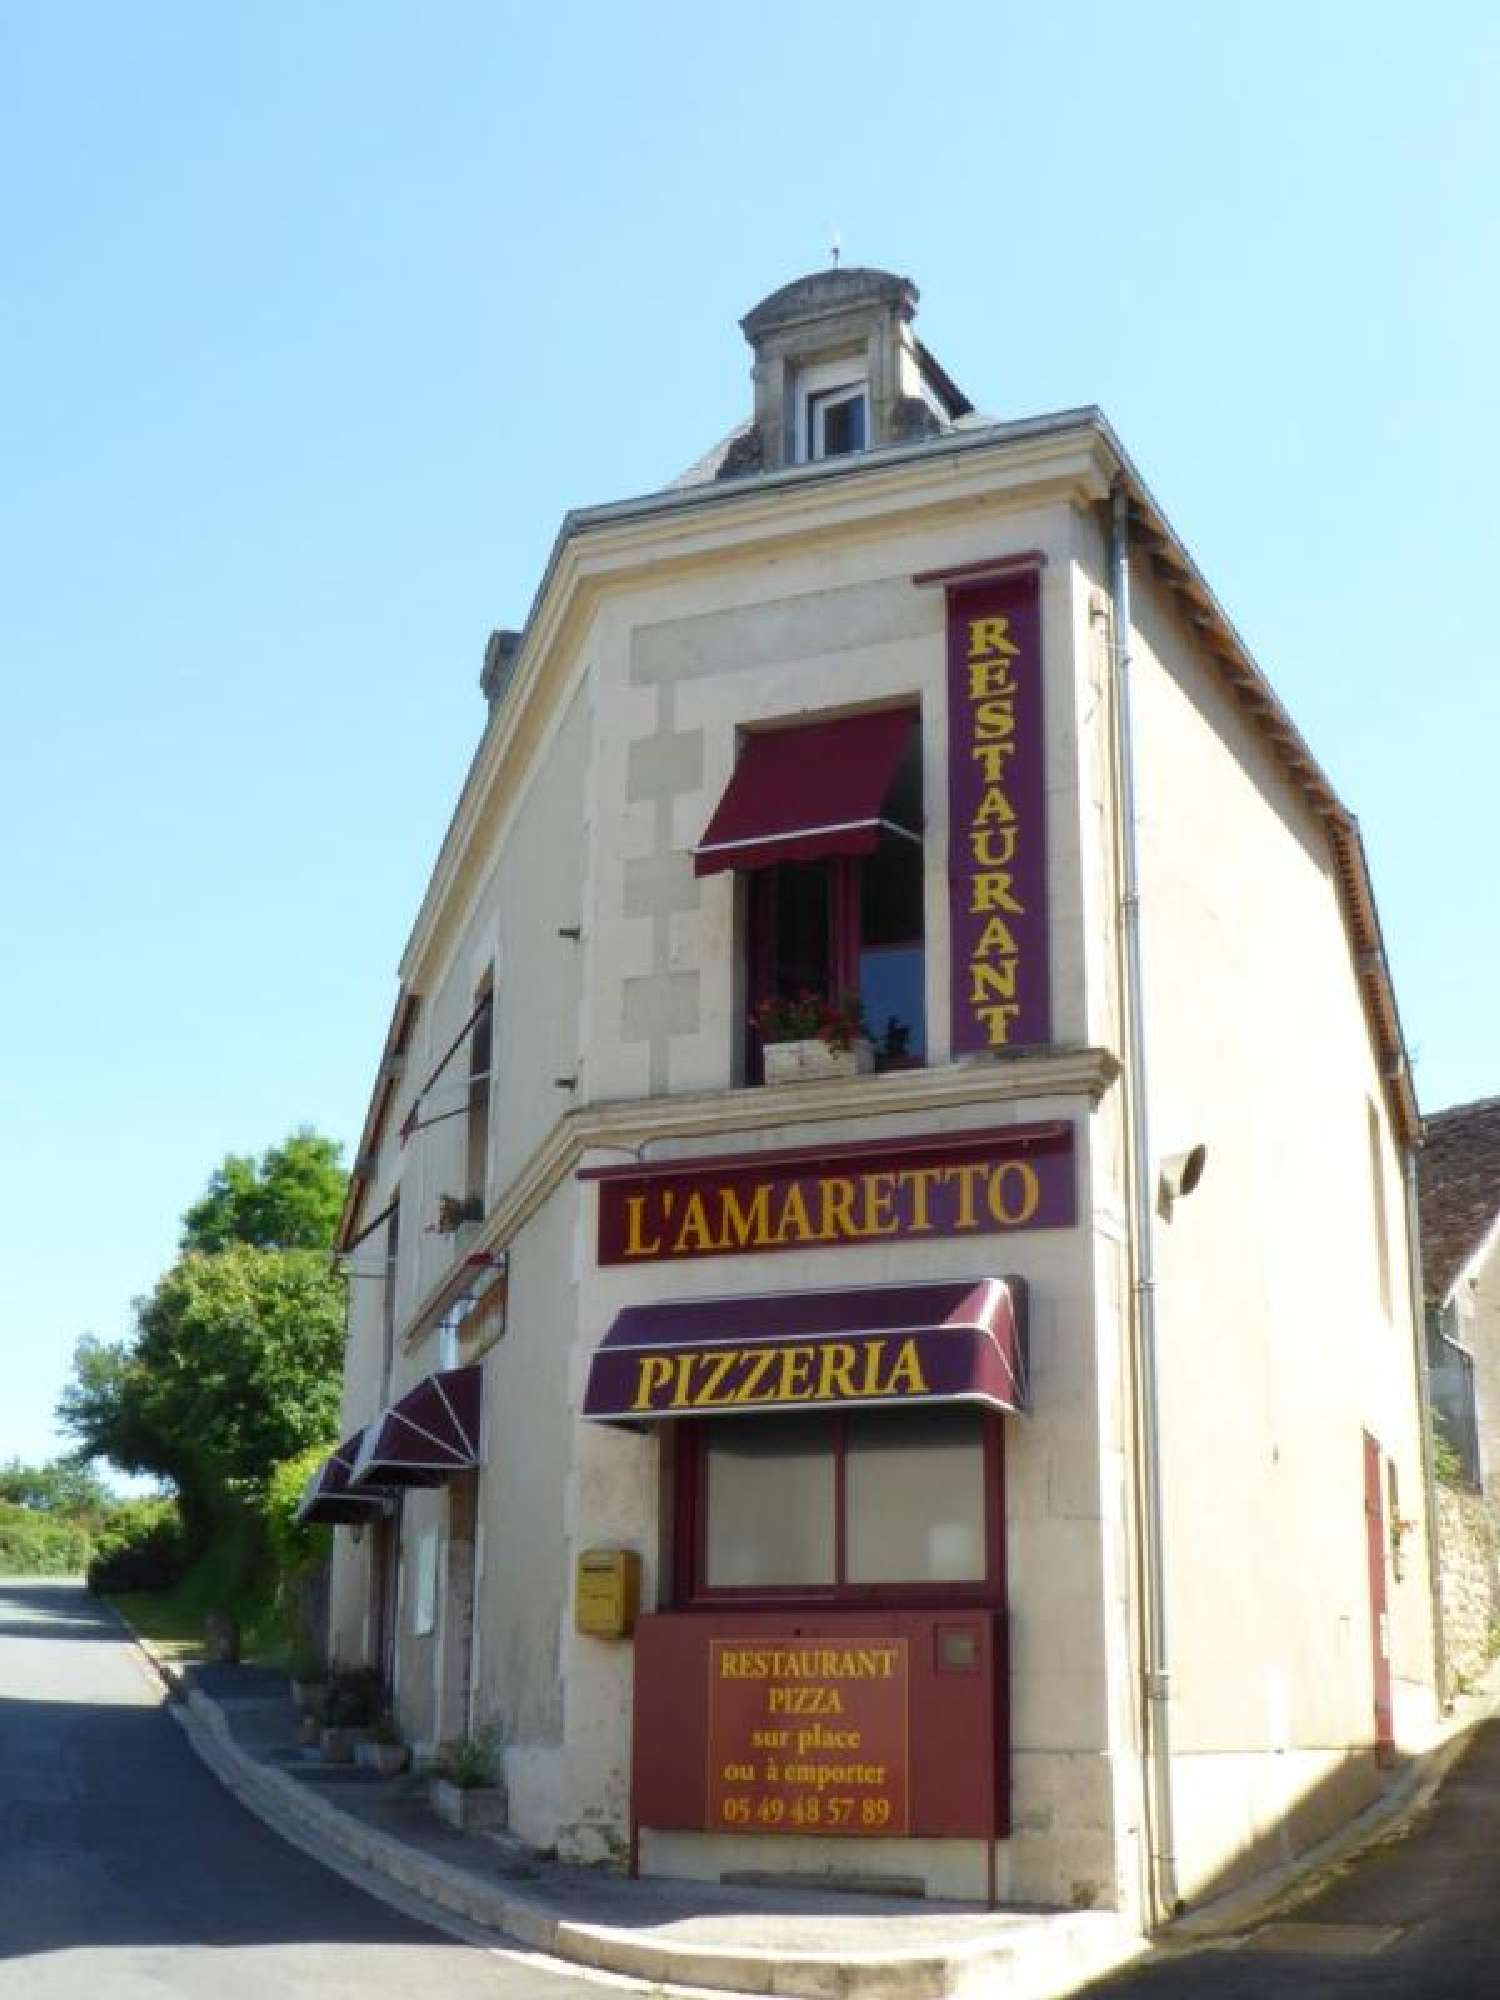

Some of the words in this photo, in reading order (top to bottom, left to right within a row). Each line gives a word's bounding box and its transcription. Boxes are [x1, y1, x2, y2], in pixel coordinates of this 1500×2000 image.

[968, 617, 1024, 1046] RESTAURANT
[624, 1160, 1040, 1256] L'AMARETTO
[631, 1338, 929, 1410] PIZZERIA
[720, 1650, 896, 1679] RESTAURANT
[768, 1687, 842, 1714] PIZZA
[752, 1729, 790, 1749] sur
[797, 1723, 861, 1755] place
[723, 1765, 754, 1781] ou
[767, 1758, 779, 1781] à
[784, 1763, 887, 1790] emporter
[723, 1798, 750, 1824] 05
